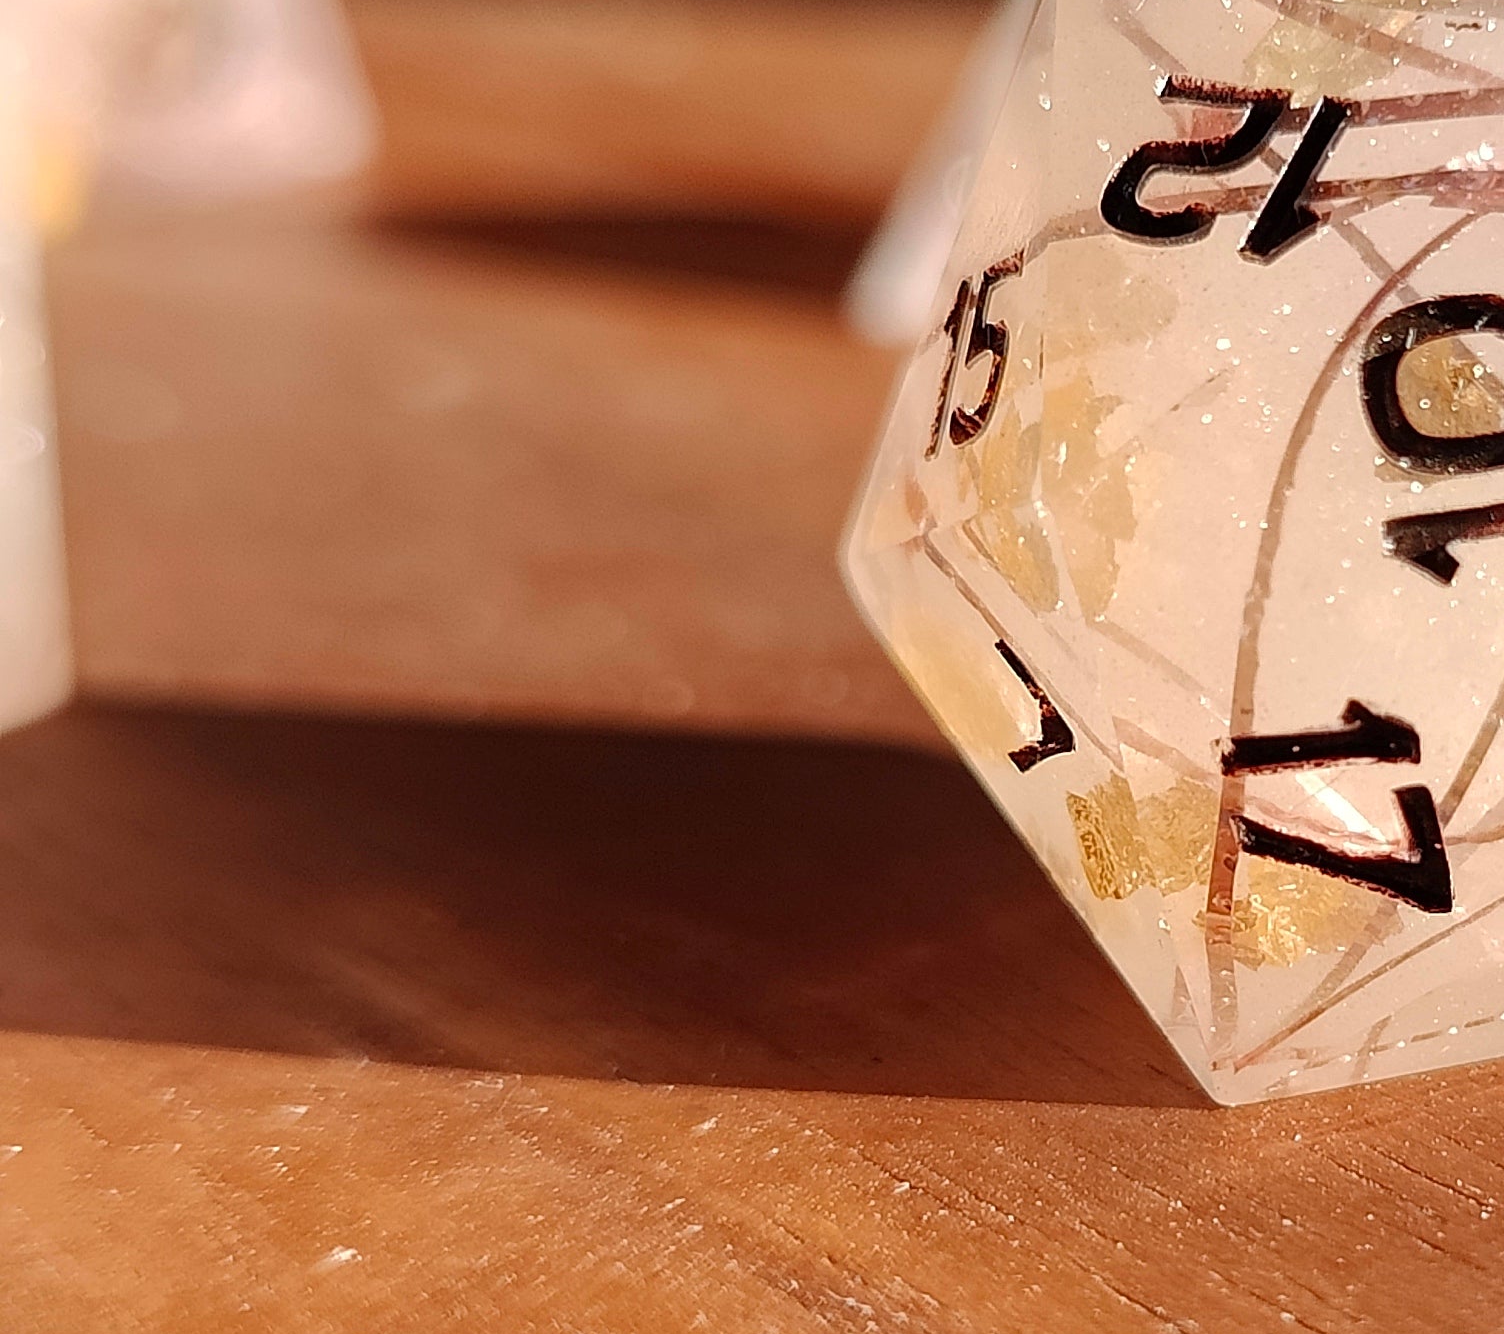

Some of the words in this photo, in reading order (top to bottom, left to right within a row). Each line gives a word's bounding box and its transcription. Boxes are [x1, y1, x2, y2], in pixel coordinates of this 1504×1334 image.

[1099, 73, 1352, 265] 12
[924, 248, 1028, 460] 15
[1217, 697, 1455, 915] 17
